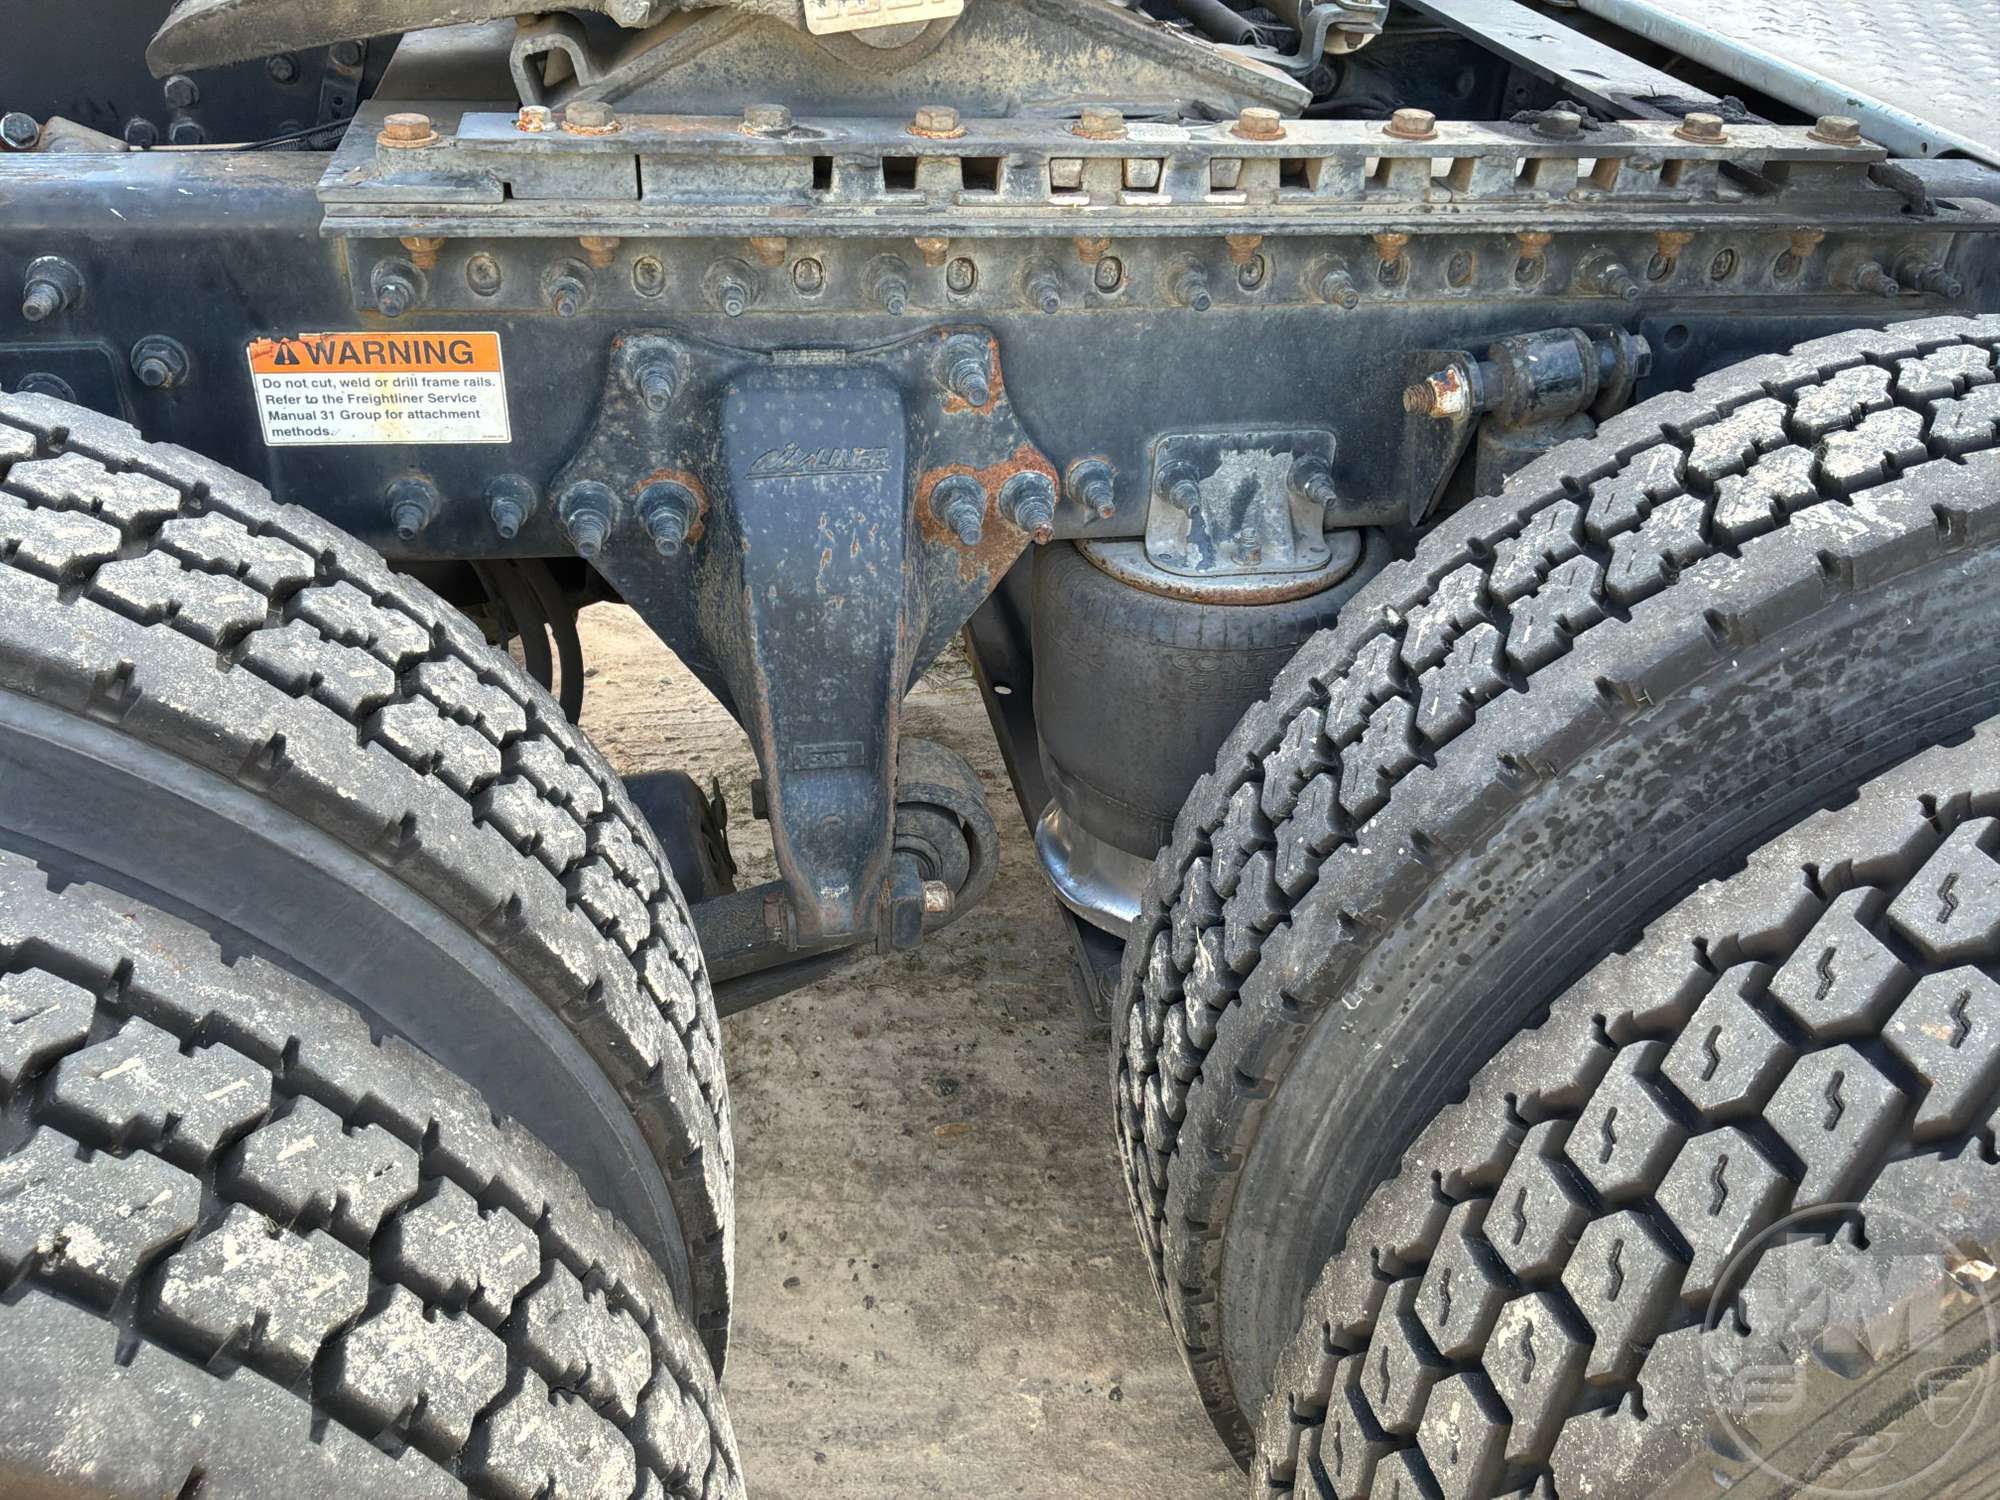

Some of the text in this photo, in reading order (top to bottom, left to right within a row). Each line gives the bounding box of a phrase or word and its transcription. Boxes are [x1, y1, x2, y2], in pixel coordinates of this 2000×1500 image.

[303, 339, 475, 366] WARNING
[262, 377, 496, 390] Do not cut, weld or drill frame rails.
[265, 393, 477, 406] Refer to the Freightliner Service
[268, 409, 481, 421] Manual 31 Group for attachment
[272, 426, 334, 437] methods.
